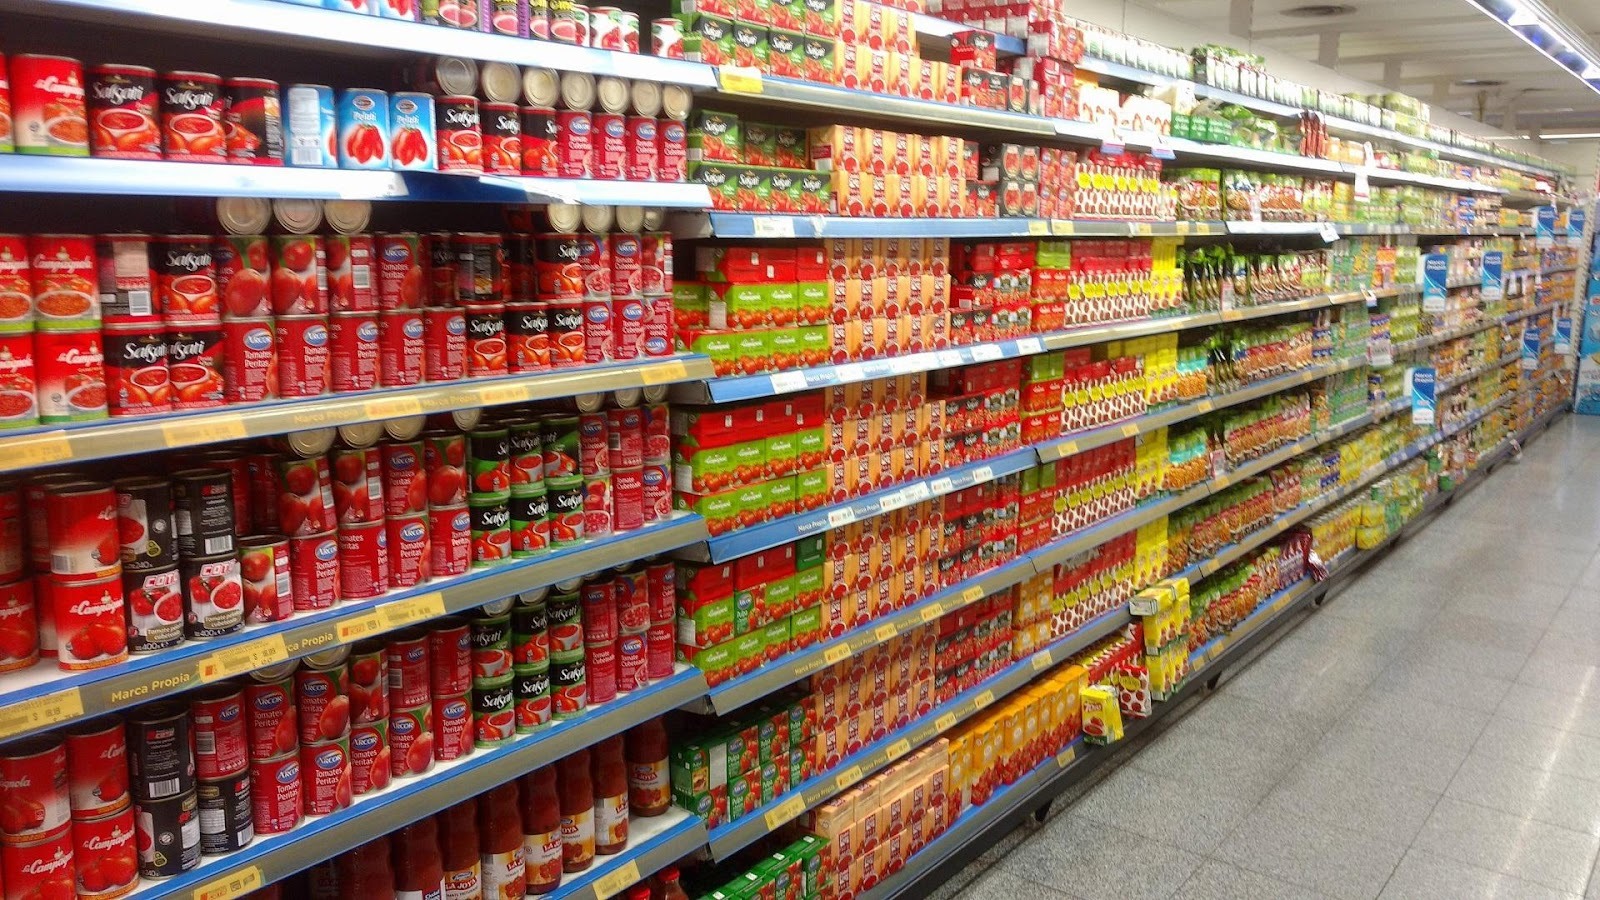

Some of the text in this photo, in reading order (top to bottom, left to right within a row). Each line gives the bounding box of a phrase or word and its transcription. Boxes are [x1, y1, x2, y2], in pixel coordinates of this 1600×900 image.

[301, 633, 334, 648] Propia
[111, 672, 191, 700] Marca Propia
[254, 710, 283, 719] Tomates
[254, 719, 279, 728] Peritas
[443, 725, 463, 734] Peritas
[351, 750, 378, 759] Tomates
[352, 758, 373, 766] Peritas
[315, 768, 342, 778] Tomates
[316, 777, 339, 786] Peritas
[457, 878, 477, 889] JOYA
